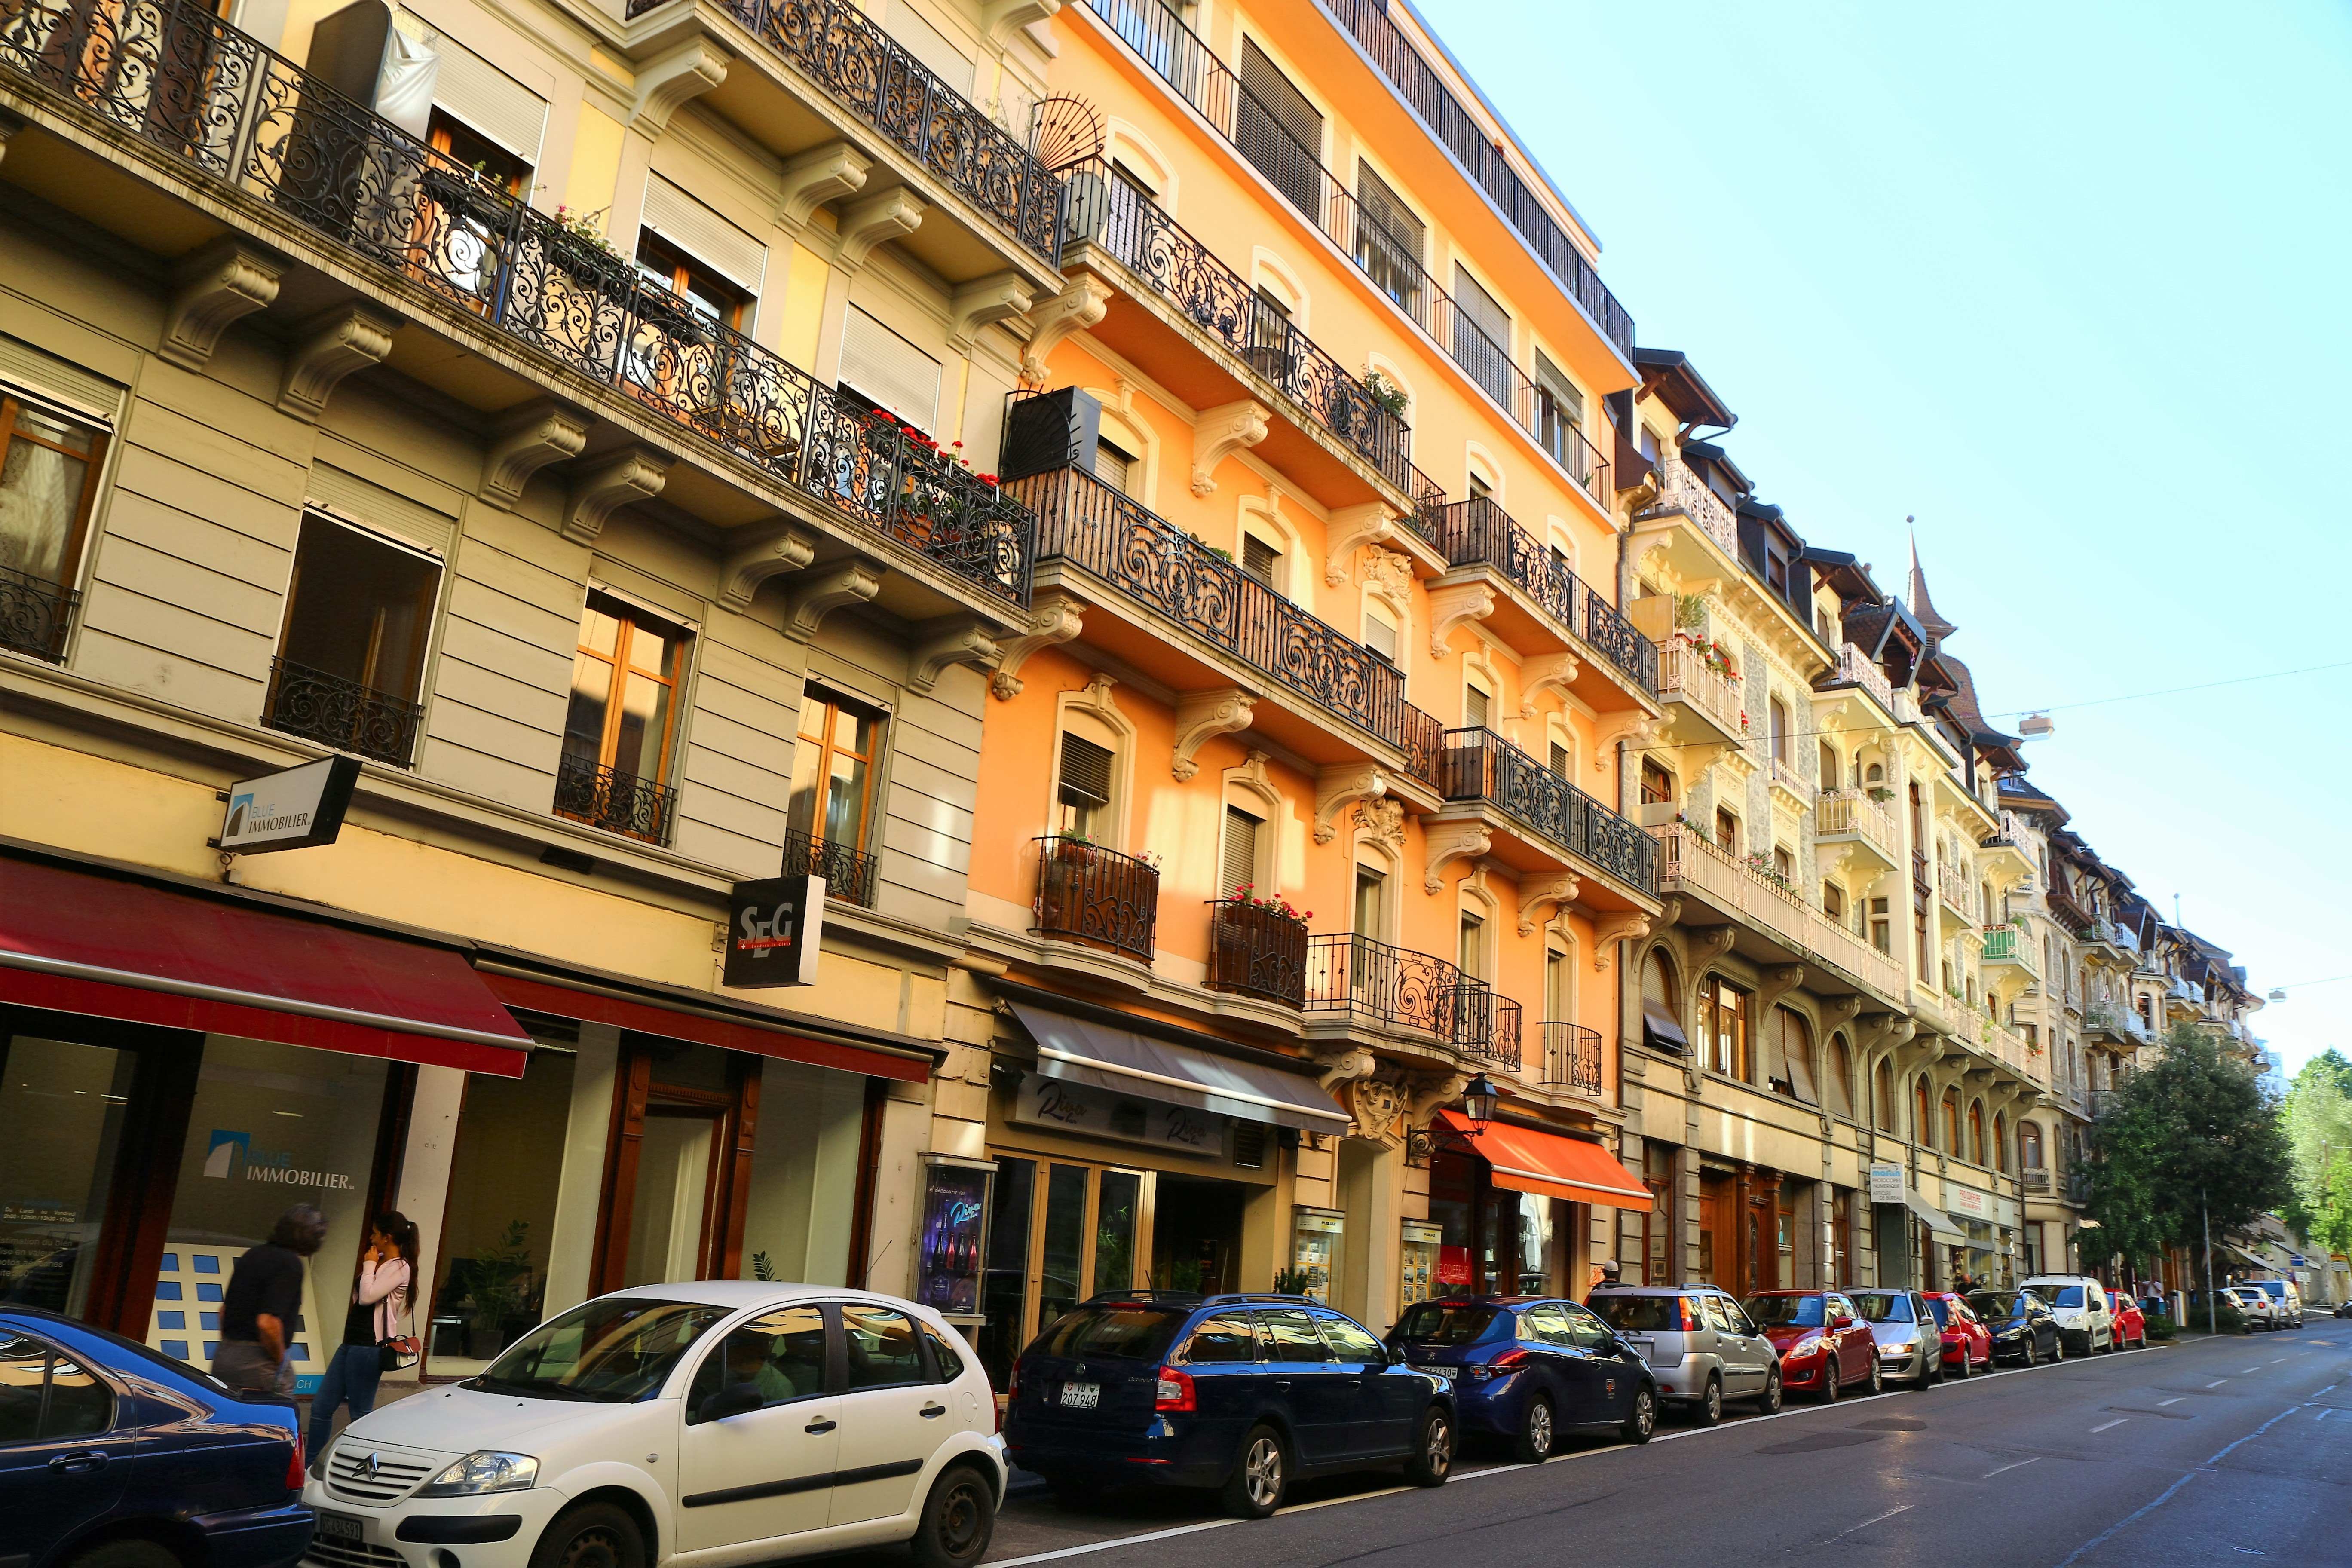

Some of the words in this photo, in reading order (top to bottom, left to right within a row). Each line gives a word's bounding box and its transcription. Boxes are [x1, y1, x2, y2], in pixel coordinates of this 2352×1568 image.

[248, 813, 308, 833] IMMOBILIER
[252, 804, 275, 818] BLUE
[738, 903, 792, 958] SEG
[1038, 1081, 1087, 1120] Riva
[1166, 1107, 1207, 1142] Riva
[247, 1166, 349, 1189] IMMOBILIER
[950, 1201, 981, 1228] Riva
[1077, 1384, 1086, 1392] VD
